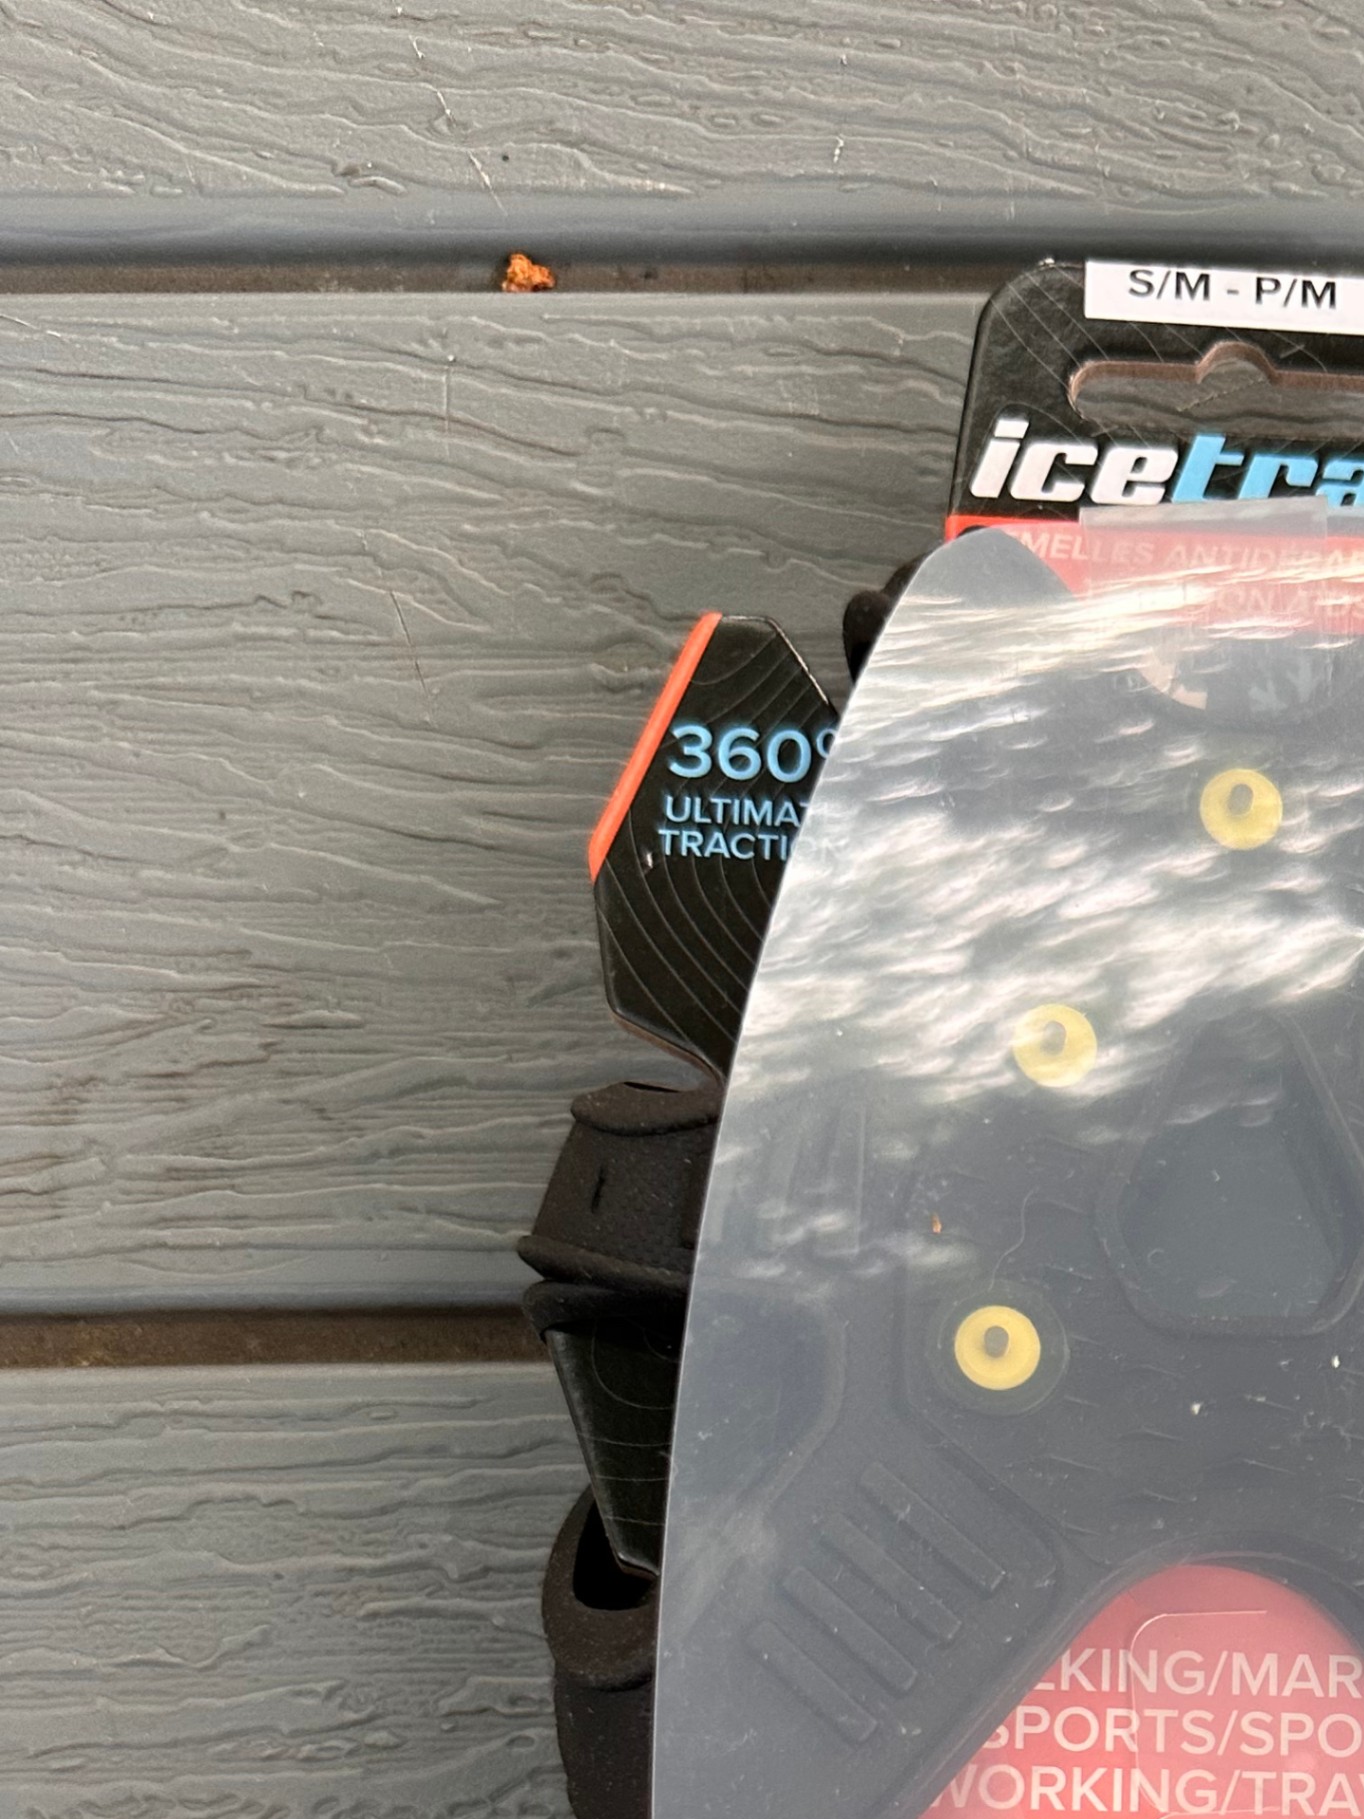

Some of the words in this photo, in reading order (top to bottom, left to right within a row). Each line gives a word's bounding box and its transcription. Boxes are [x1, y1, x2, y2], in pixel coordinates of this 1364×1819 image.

[1127, 268, 1212, 302] S/M
[1254, 276, 1338, 309] P/M
[664, 796, 842, 827] ULTIMA
[658, 828, 846, 861] TRACTI
